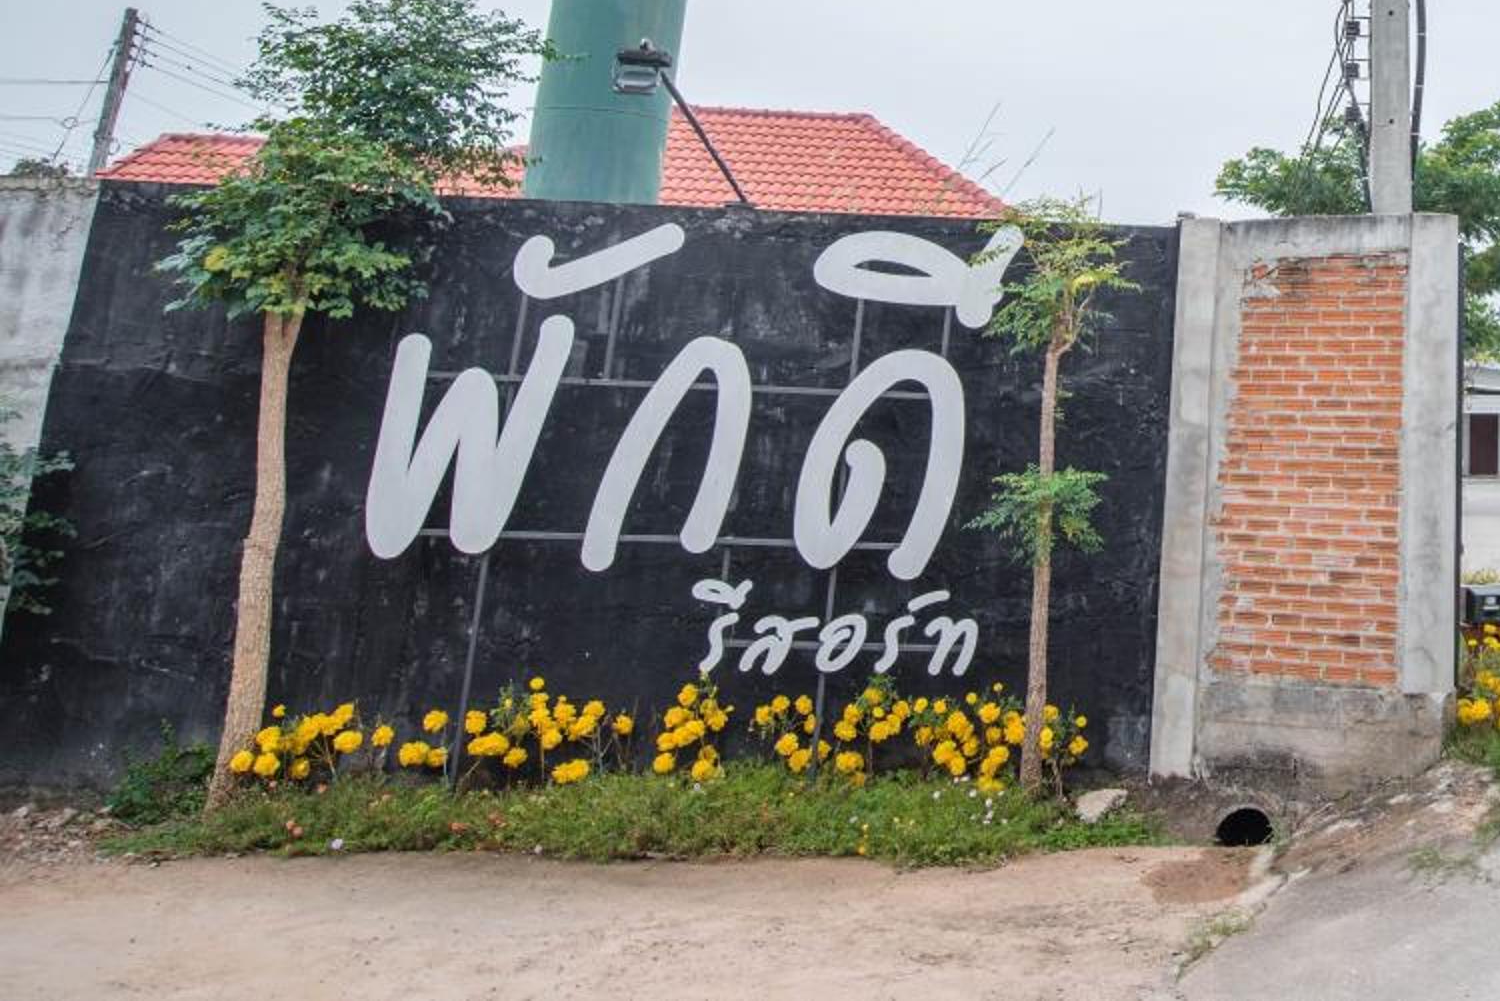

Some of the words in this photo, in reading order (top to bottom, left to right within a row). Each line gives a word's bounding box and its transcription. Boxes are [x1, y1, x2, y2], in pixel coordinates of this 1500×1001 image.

[365, 223, 1024, 580] พักดี
[691, 579, 979, 676] รีสอร์ท
